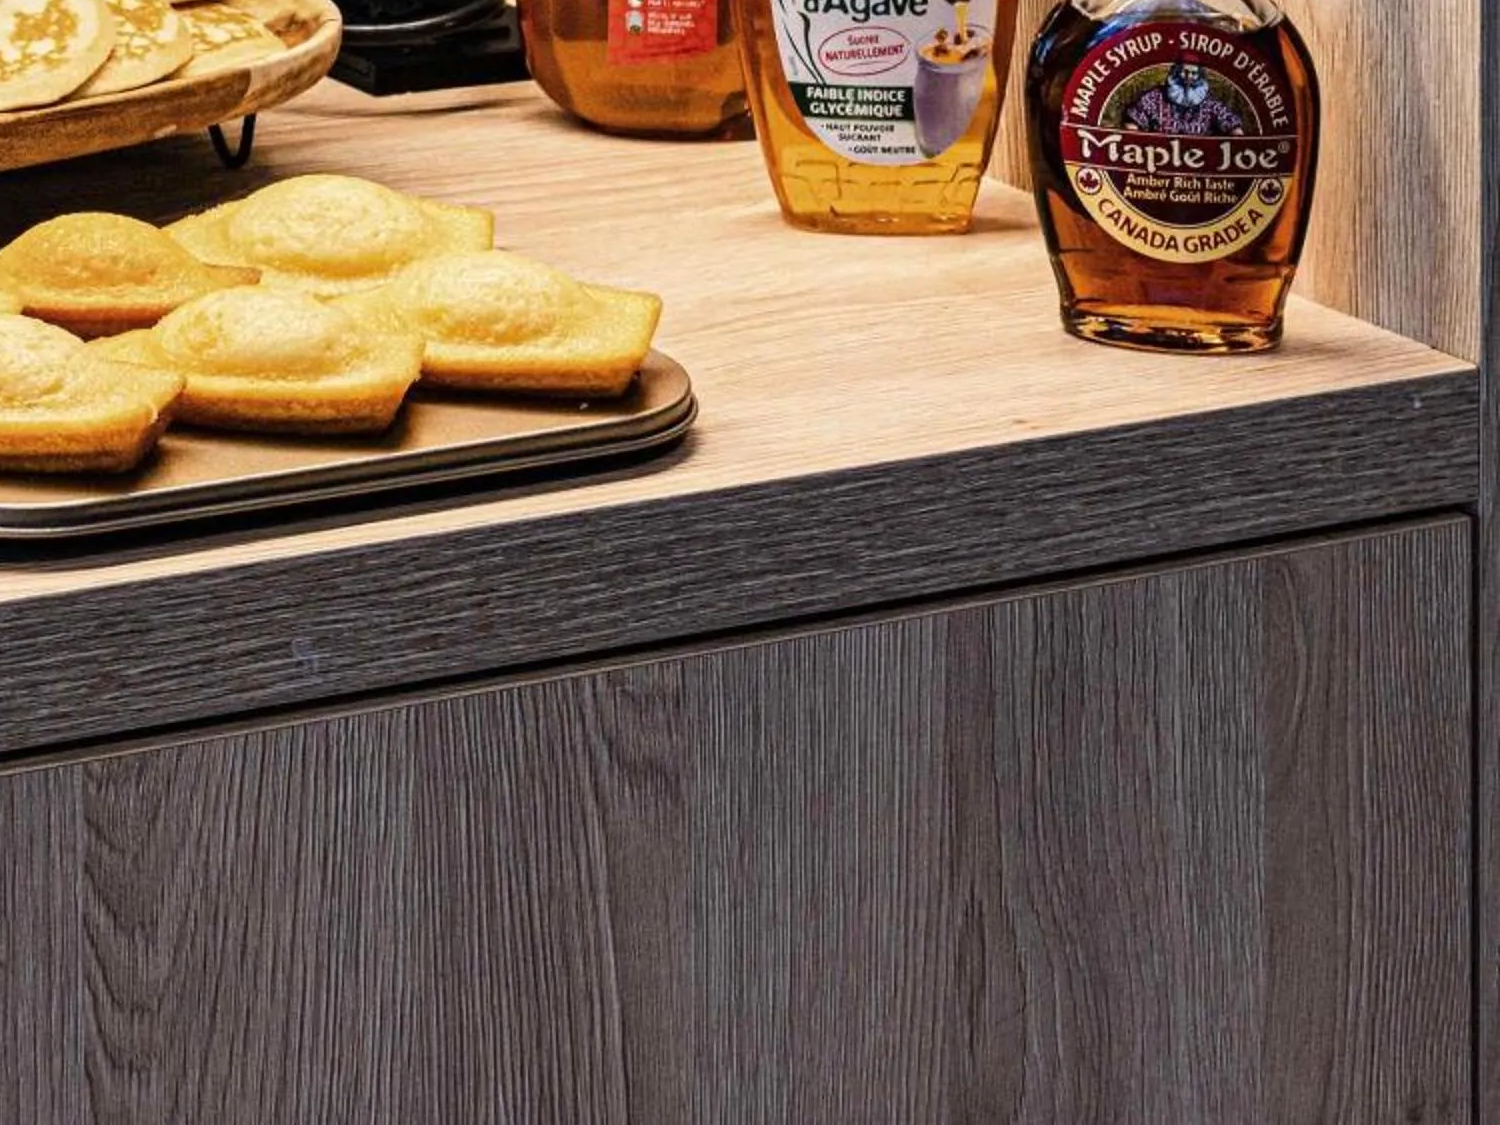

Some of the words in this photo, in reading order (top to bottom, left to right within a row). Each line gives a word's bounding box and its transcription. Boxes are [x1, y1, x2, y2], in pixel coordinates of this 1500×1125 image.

[1070, 58, 1111, 119] MAPLE
[1105, 31, 1163, 68] SYRUP
[1179, 30, 1235, 59] SIROP
[806, 86, 855, 101] FAIBLE
[858, 88, 906, 102] INDICE
[809, 99, 904, 117] GLYCÉMIQUE
[1077, 129, 1205, 173] Maple
[1126, 174, 1169, 188] Amber
[1173, 175, 1200, 189] Rich
[1203, 177, 1235, 191] Taste
[1123, 186, 1167, 202] Ambré
[1203, 190, 1239, 205] Riche
[1098, 198, 1179, 253] CANADA
[1183, 219, 1250, 254] GRADE
[1247, 208, 1264, 224] A
